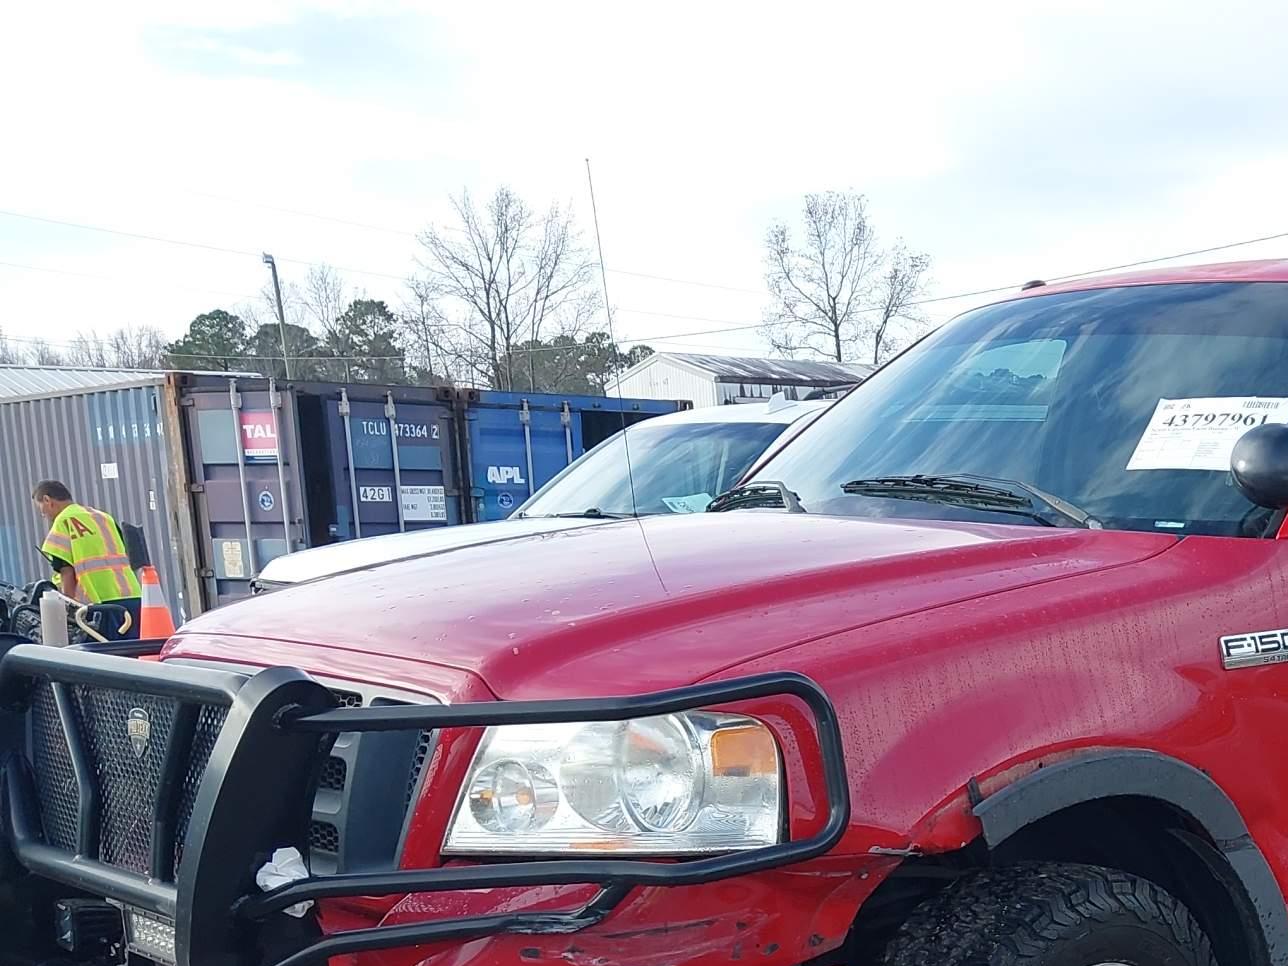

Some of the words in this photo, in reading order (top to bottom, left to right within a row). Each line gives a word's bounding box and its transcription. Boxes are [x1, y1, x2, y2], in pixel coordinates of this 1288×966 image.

[1162, 412, 1269, 427] 43797961
[242, 423, 276, 439] TAL
[362, 421, 387, 436] TCLU
[487, 465, 526, 484] APL
[361, 487, 391, 501] 42G1
